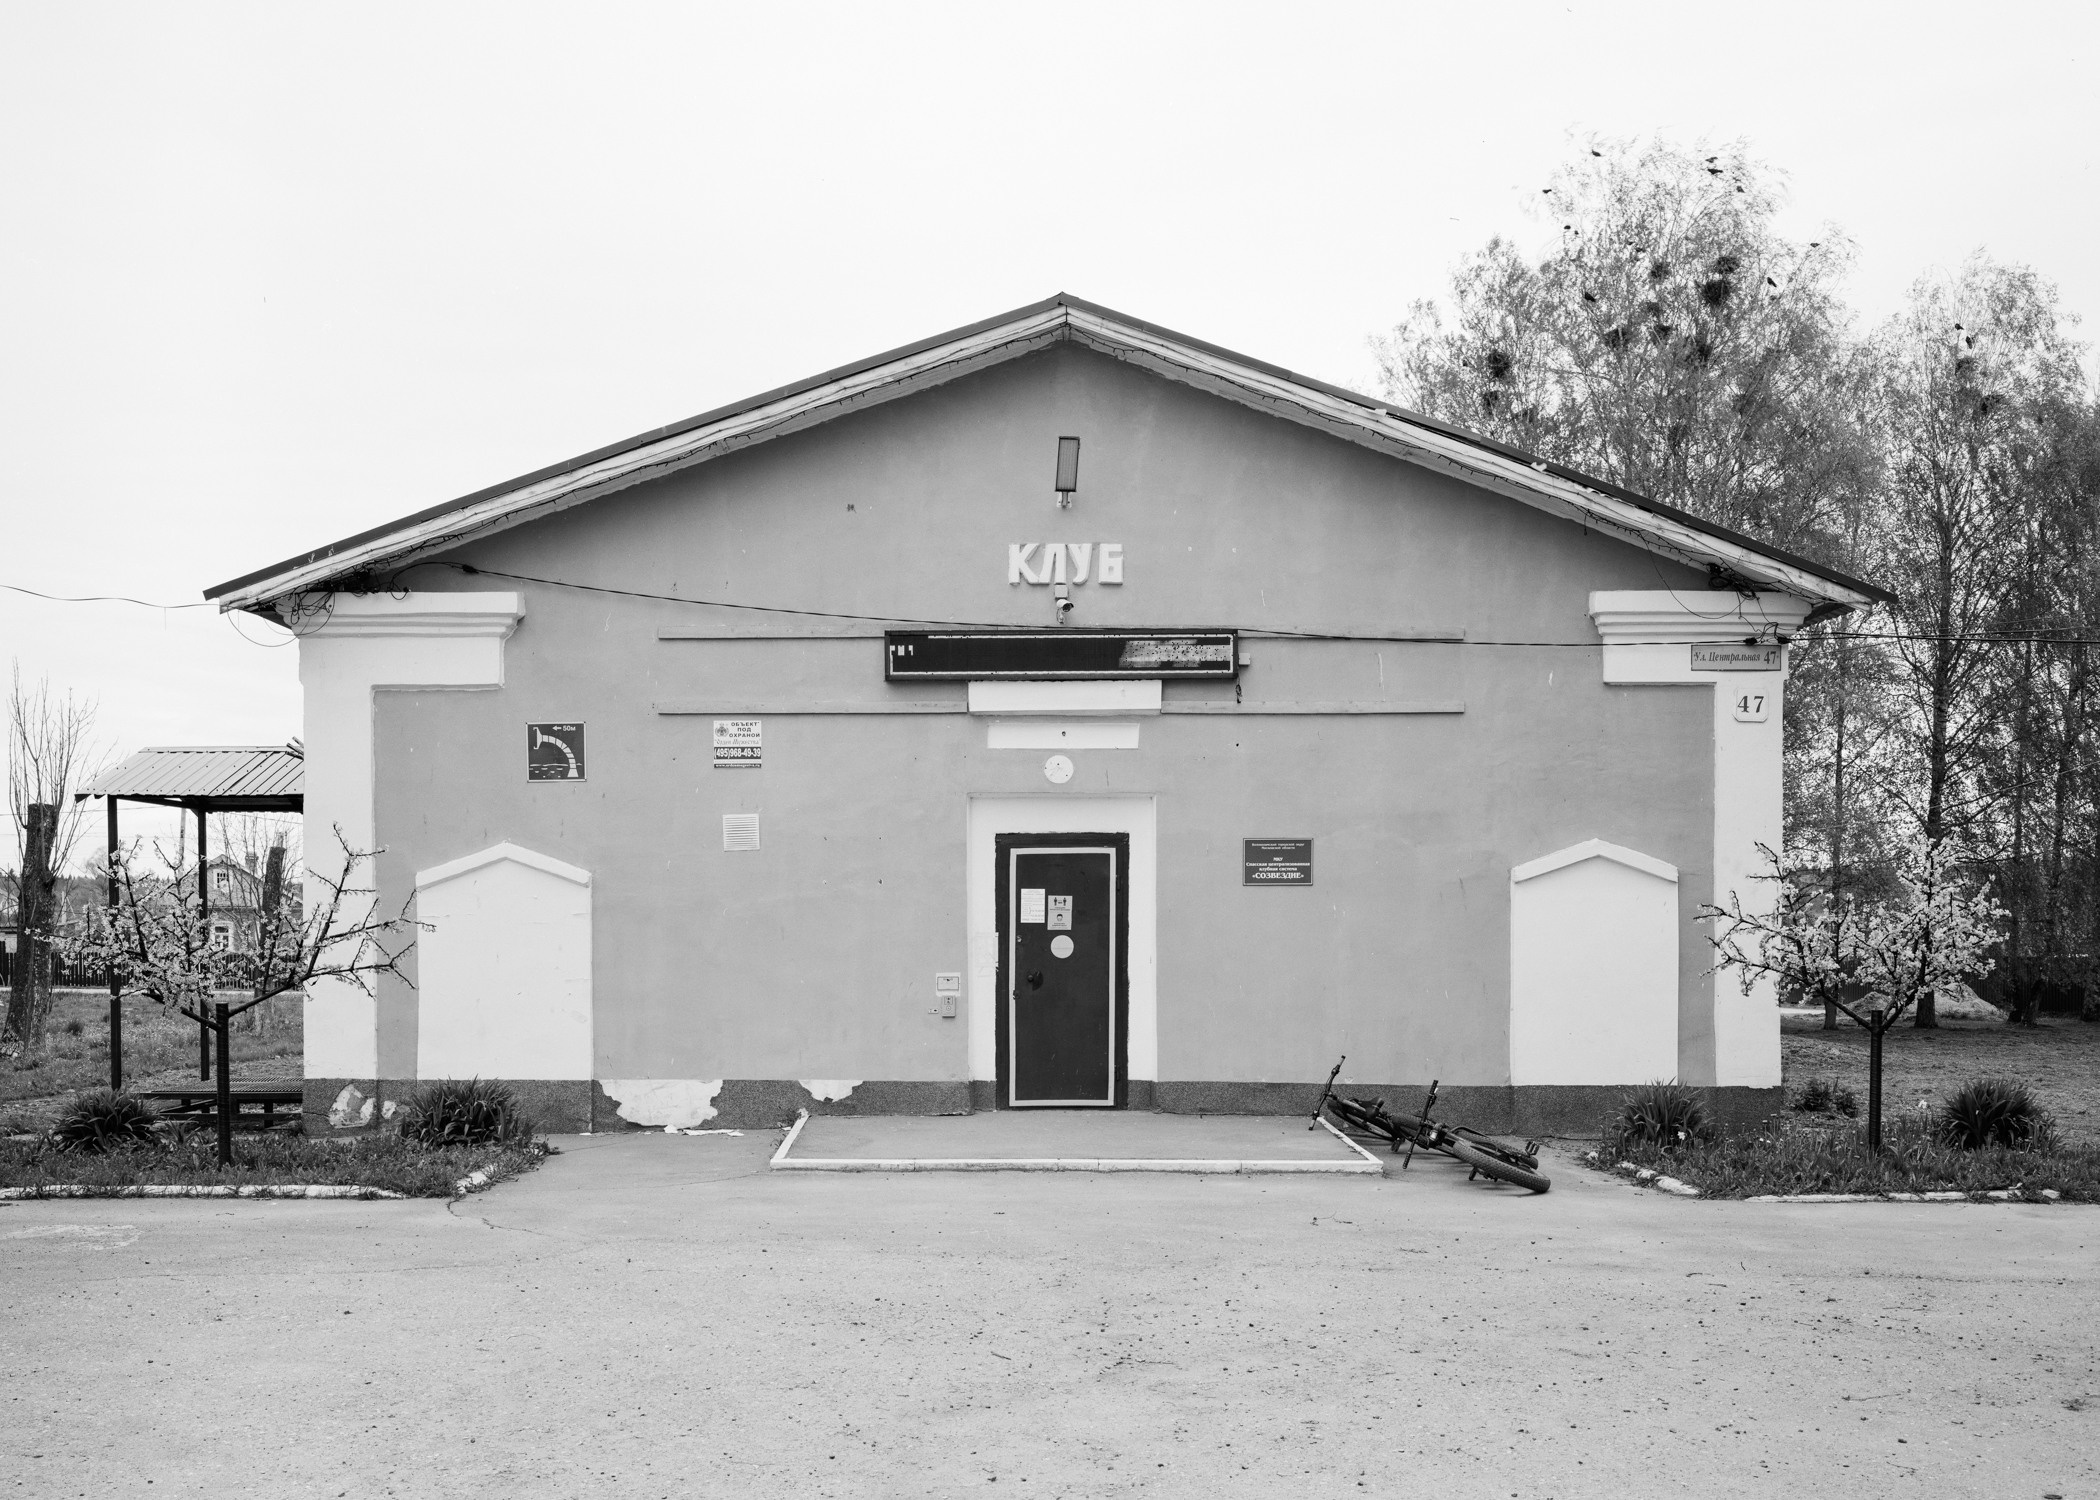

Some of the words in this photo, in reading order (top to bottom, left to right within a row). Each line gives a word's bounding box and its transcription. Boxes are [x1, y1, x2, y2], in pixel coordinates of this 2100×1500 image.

[1008, 543, 1123, 586] КЛУБ
[1709, 652, 1760, 664] Центральная
[1764, 651, 1776, 664] 47
[1737, 696, 1764, 713] 47
